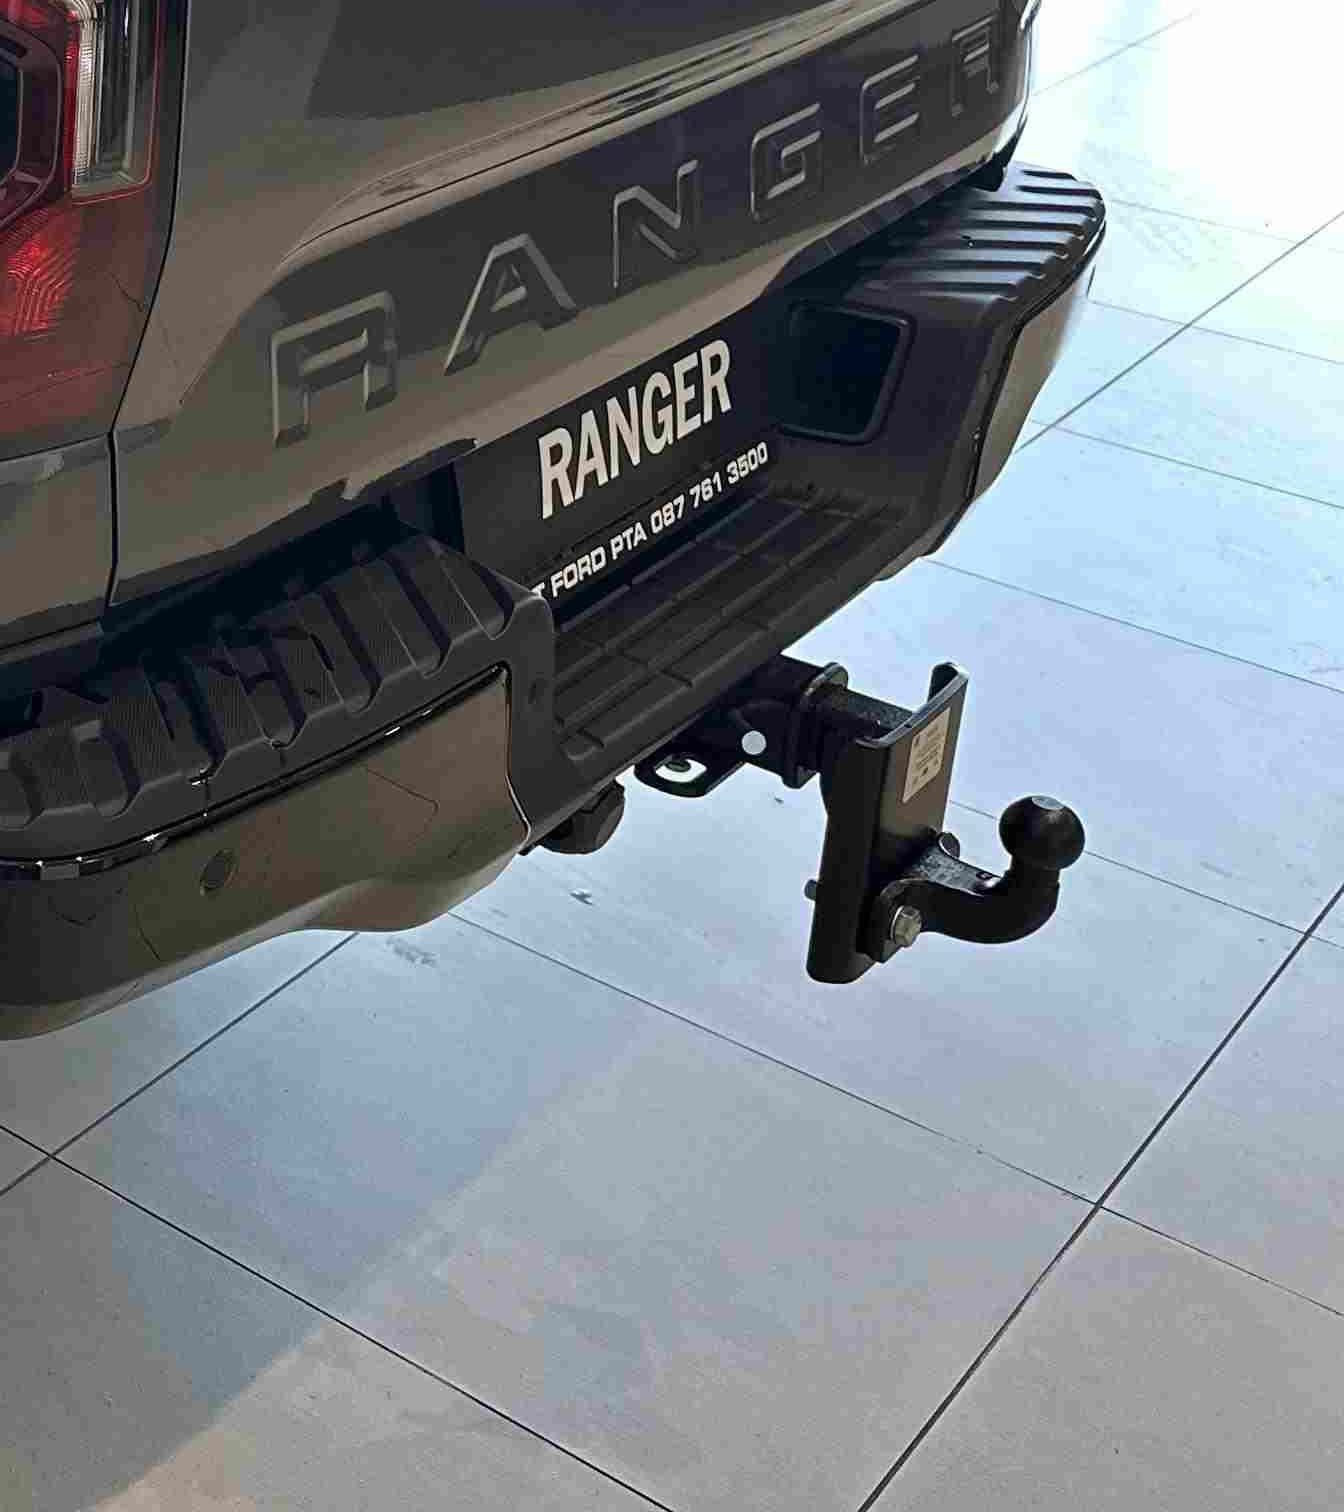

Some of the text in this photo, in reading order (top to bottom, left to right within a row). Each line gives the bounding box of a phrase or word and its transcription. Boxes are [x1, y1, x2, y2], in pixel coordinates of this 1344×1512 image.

[271, 17, 999, 449] RANGER
[538, 339, 733, 519] RANGER
[550, 440, 769, 598] FORD PTA 087 761 3500
